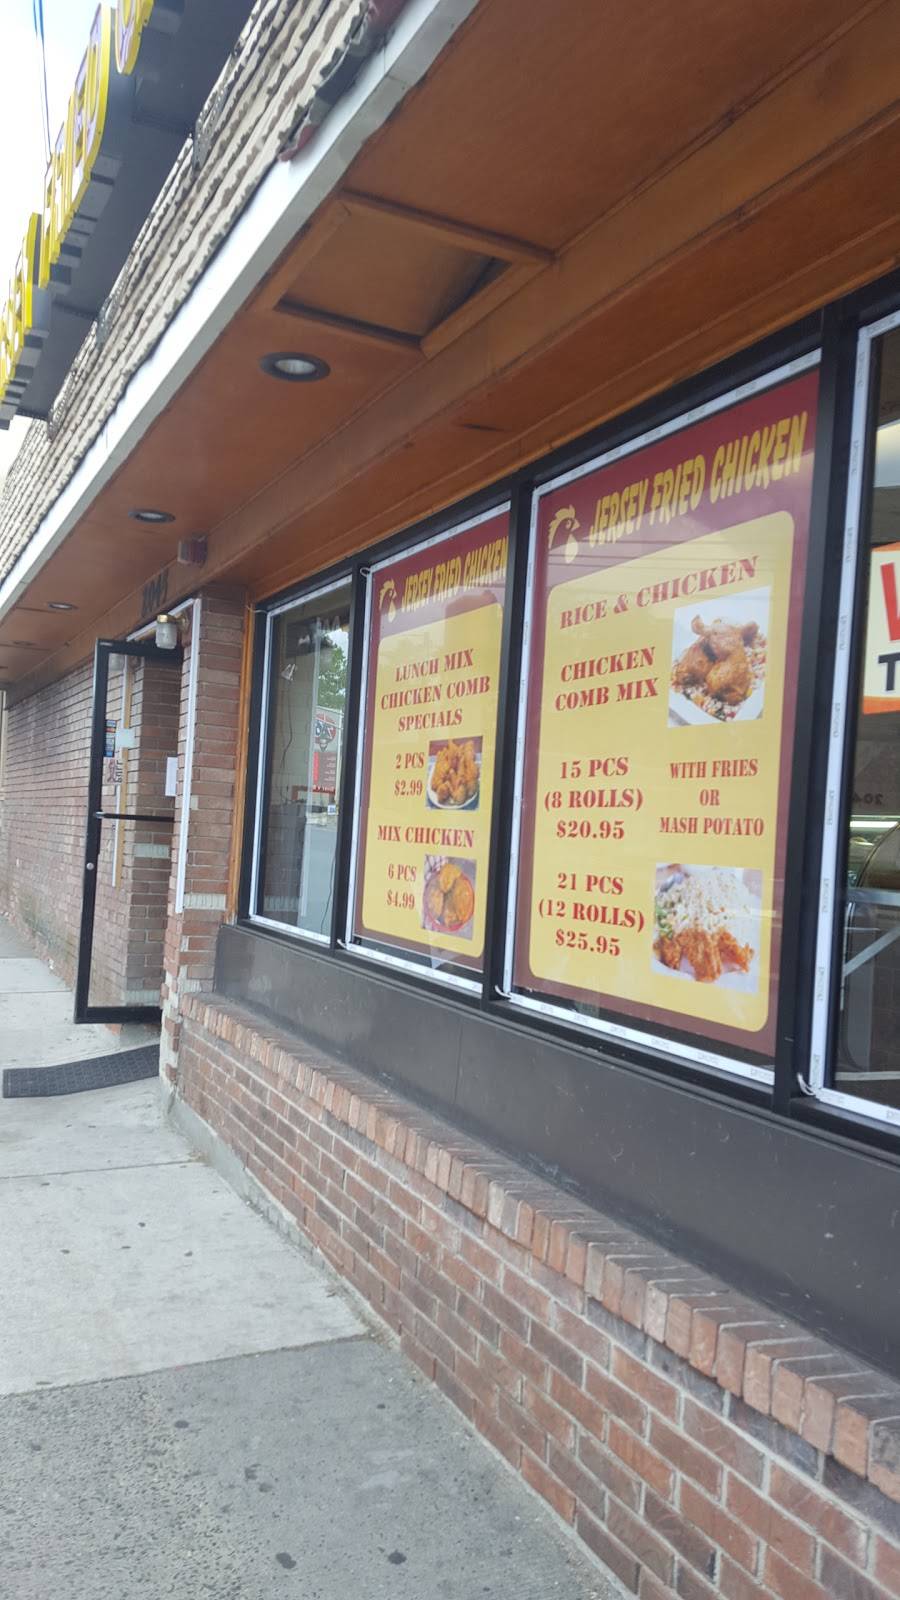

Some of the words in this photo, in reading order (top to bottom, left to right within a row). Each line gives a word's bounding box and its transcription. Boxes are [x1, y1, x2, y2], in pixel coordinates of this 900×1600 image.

[589, 478, 649, 548] JERSEY
[650, 454, 705, 526] FRIED
[710, 411, 808, 504] CHICKEN
[401, 567, 434, 613] JERSEY
[432, 555, 463, 603] FRIED
[463, 535, 508, 592] CHICKEN
[559, 599, 607, 630] RICE
[613, 592, 629, 614] &
[636, 556, 759, 609] CHICKEN
[395, 656, 439, 682] LUNCH
[444, 648, 474, 671] MIX
[560, 646, 656, 683] CHICKEN
[381, 684, 442, 710] CHICKEN
[446, 675, 490, 699] COMB
[555, 686, 610, 712] COMB
[616, 677, 659, 702] MIX
[398, 708, 463, 732] SPECIALS
[396, 753, 402, 770] 2
[405, 752, 425, 769] PCS
[560, 760, 582, 779] 15
[589, 757, 629, 777] PCS
[670, 761, 707, 779] WITH
[712, 758, 759, 777] FRIES
[394, 779, 423, 797] $2.99
[544, 790, 562, 811] (8
[568, 788, 644, 811] ROLLS)
[699, 789, 720, 806] OR
[378, 825, 401, 842] MIX
[405, 827, 475, 848] CHICKEN
[556, 820, 625, 840] $20.95
[660, 816, 698, 834] MASH
[703, 817, 764, 836] POTATO
[388, 863, 394, 880] 6
[397, 864, 417, 882] PCS
[557, 872, 577, 891] 21
[586, 874, 624, 895] PCS
[387, 889, 416, 910] $4.99
[538, 898, 566, 919] (12
[573, 903, 645, 932] ROLLS)
[555, 928, 621, 957] $25.95
